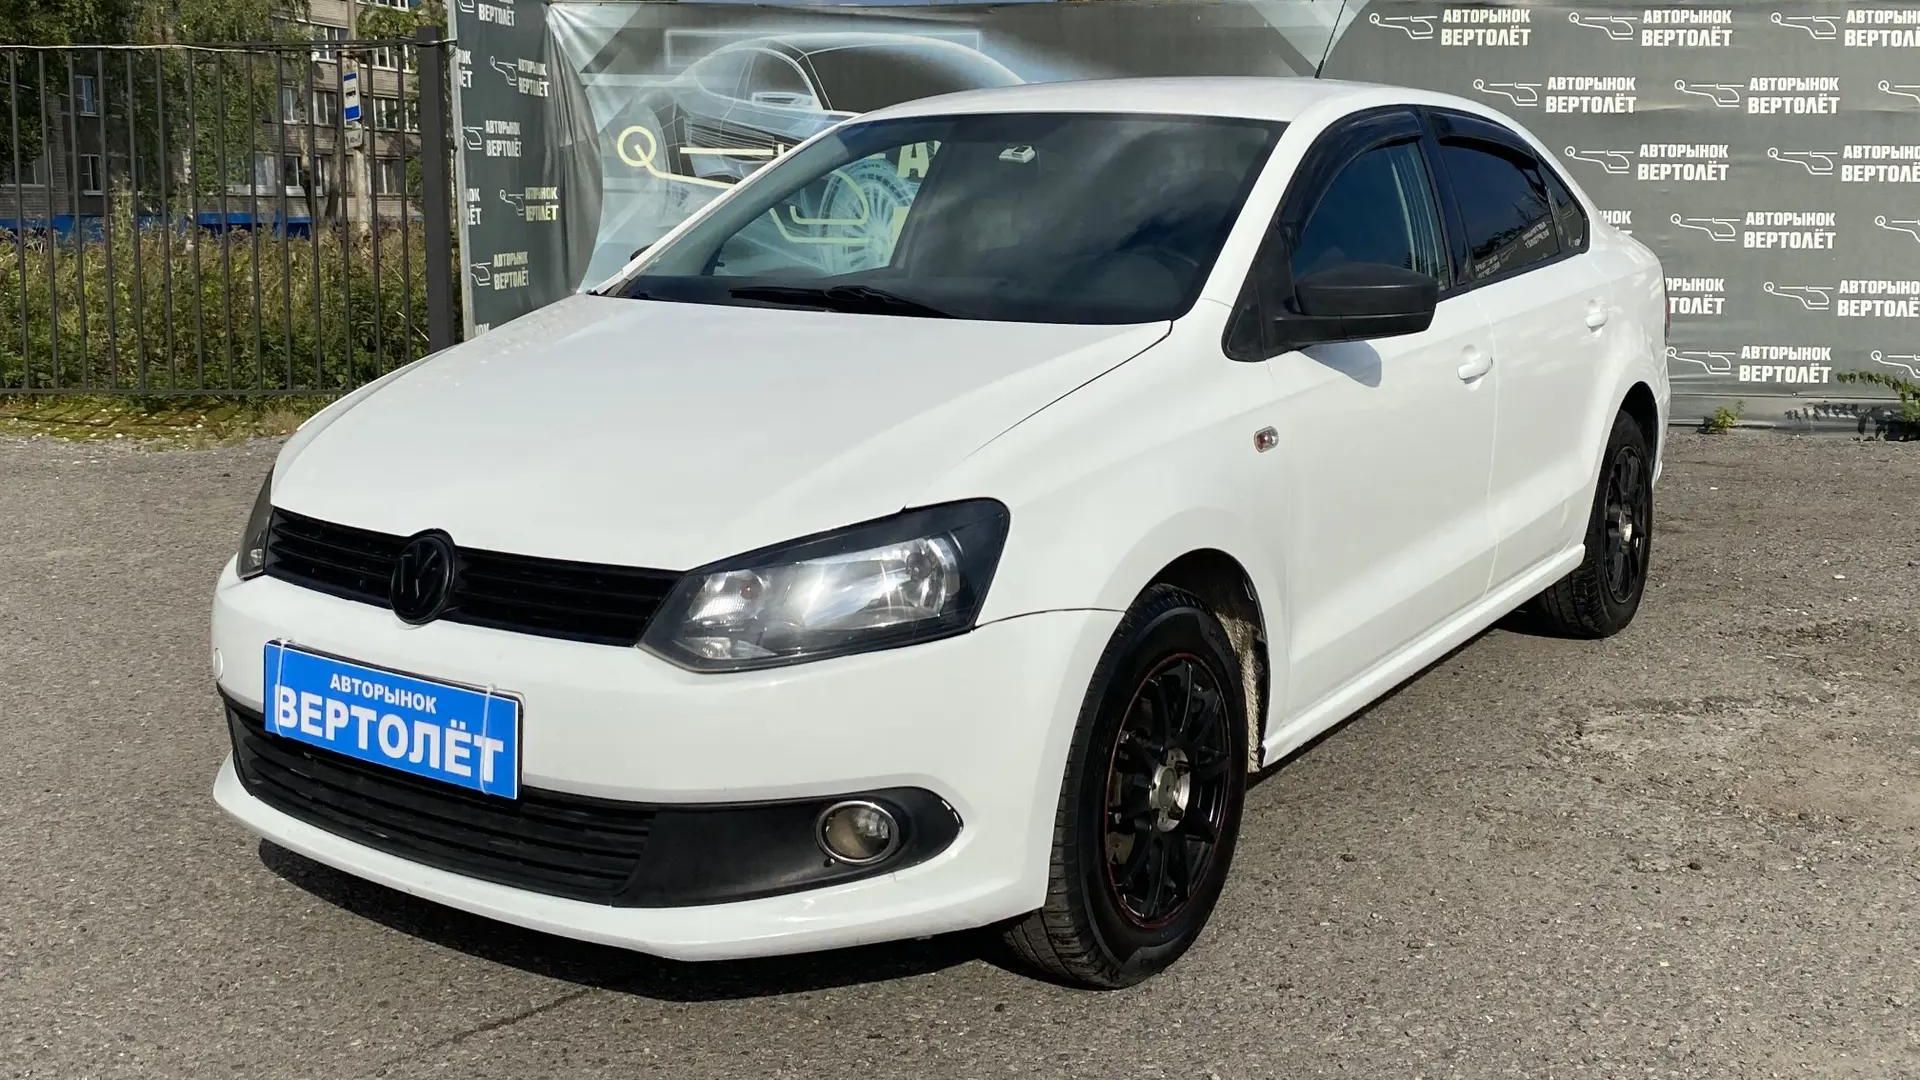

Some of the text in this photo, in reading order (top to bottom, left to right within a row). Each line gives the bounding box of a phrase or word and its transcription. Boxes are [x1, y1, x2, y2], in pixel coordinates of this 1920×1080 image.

[1442, 9, 1531, 24] АВТОРЫНОК
[1643, 9, 1732, 25] АВТОРЫНОК
[1846, 9, 1920, 25] АВТОРЫН
[1441, 25, 1531, 46] ВЕРТОЛЁТ
[1641, 26, 1733, 47] ВЕРТОЛЁТ
[1547, 77, 1636, 91] АВТОРЫНОК
[1749, 77, 1840, 92] АВТОРЫНОК
[1546, 93, 1637, 114] ВЕРТОЛЁТ
[1747, 93, 1840, 114] ВЕРТОЛЁТ
[1639, 143, 1729, 159] АВТОРЫНОК
[1638, 160, 1730, 181] ВЕРТОЛЁТ
[1745, 211, 1836, 227] АВТОРЫНОК
[1744, 228, 1837, 249] ВЕРТОЛЁТ
[1837, 297, 1920, 318] ВЕРТОЛЁ
[1741, 345, 1832, 361] АВТОРЫНОК
[1738, 363, 1832, 384] ВЕРТОЛЁТ
[330, 673, 437, 714] АВТОРЫНОК
[274, 684, 504, 783] ВЕРТОЛЁТ
